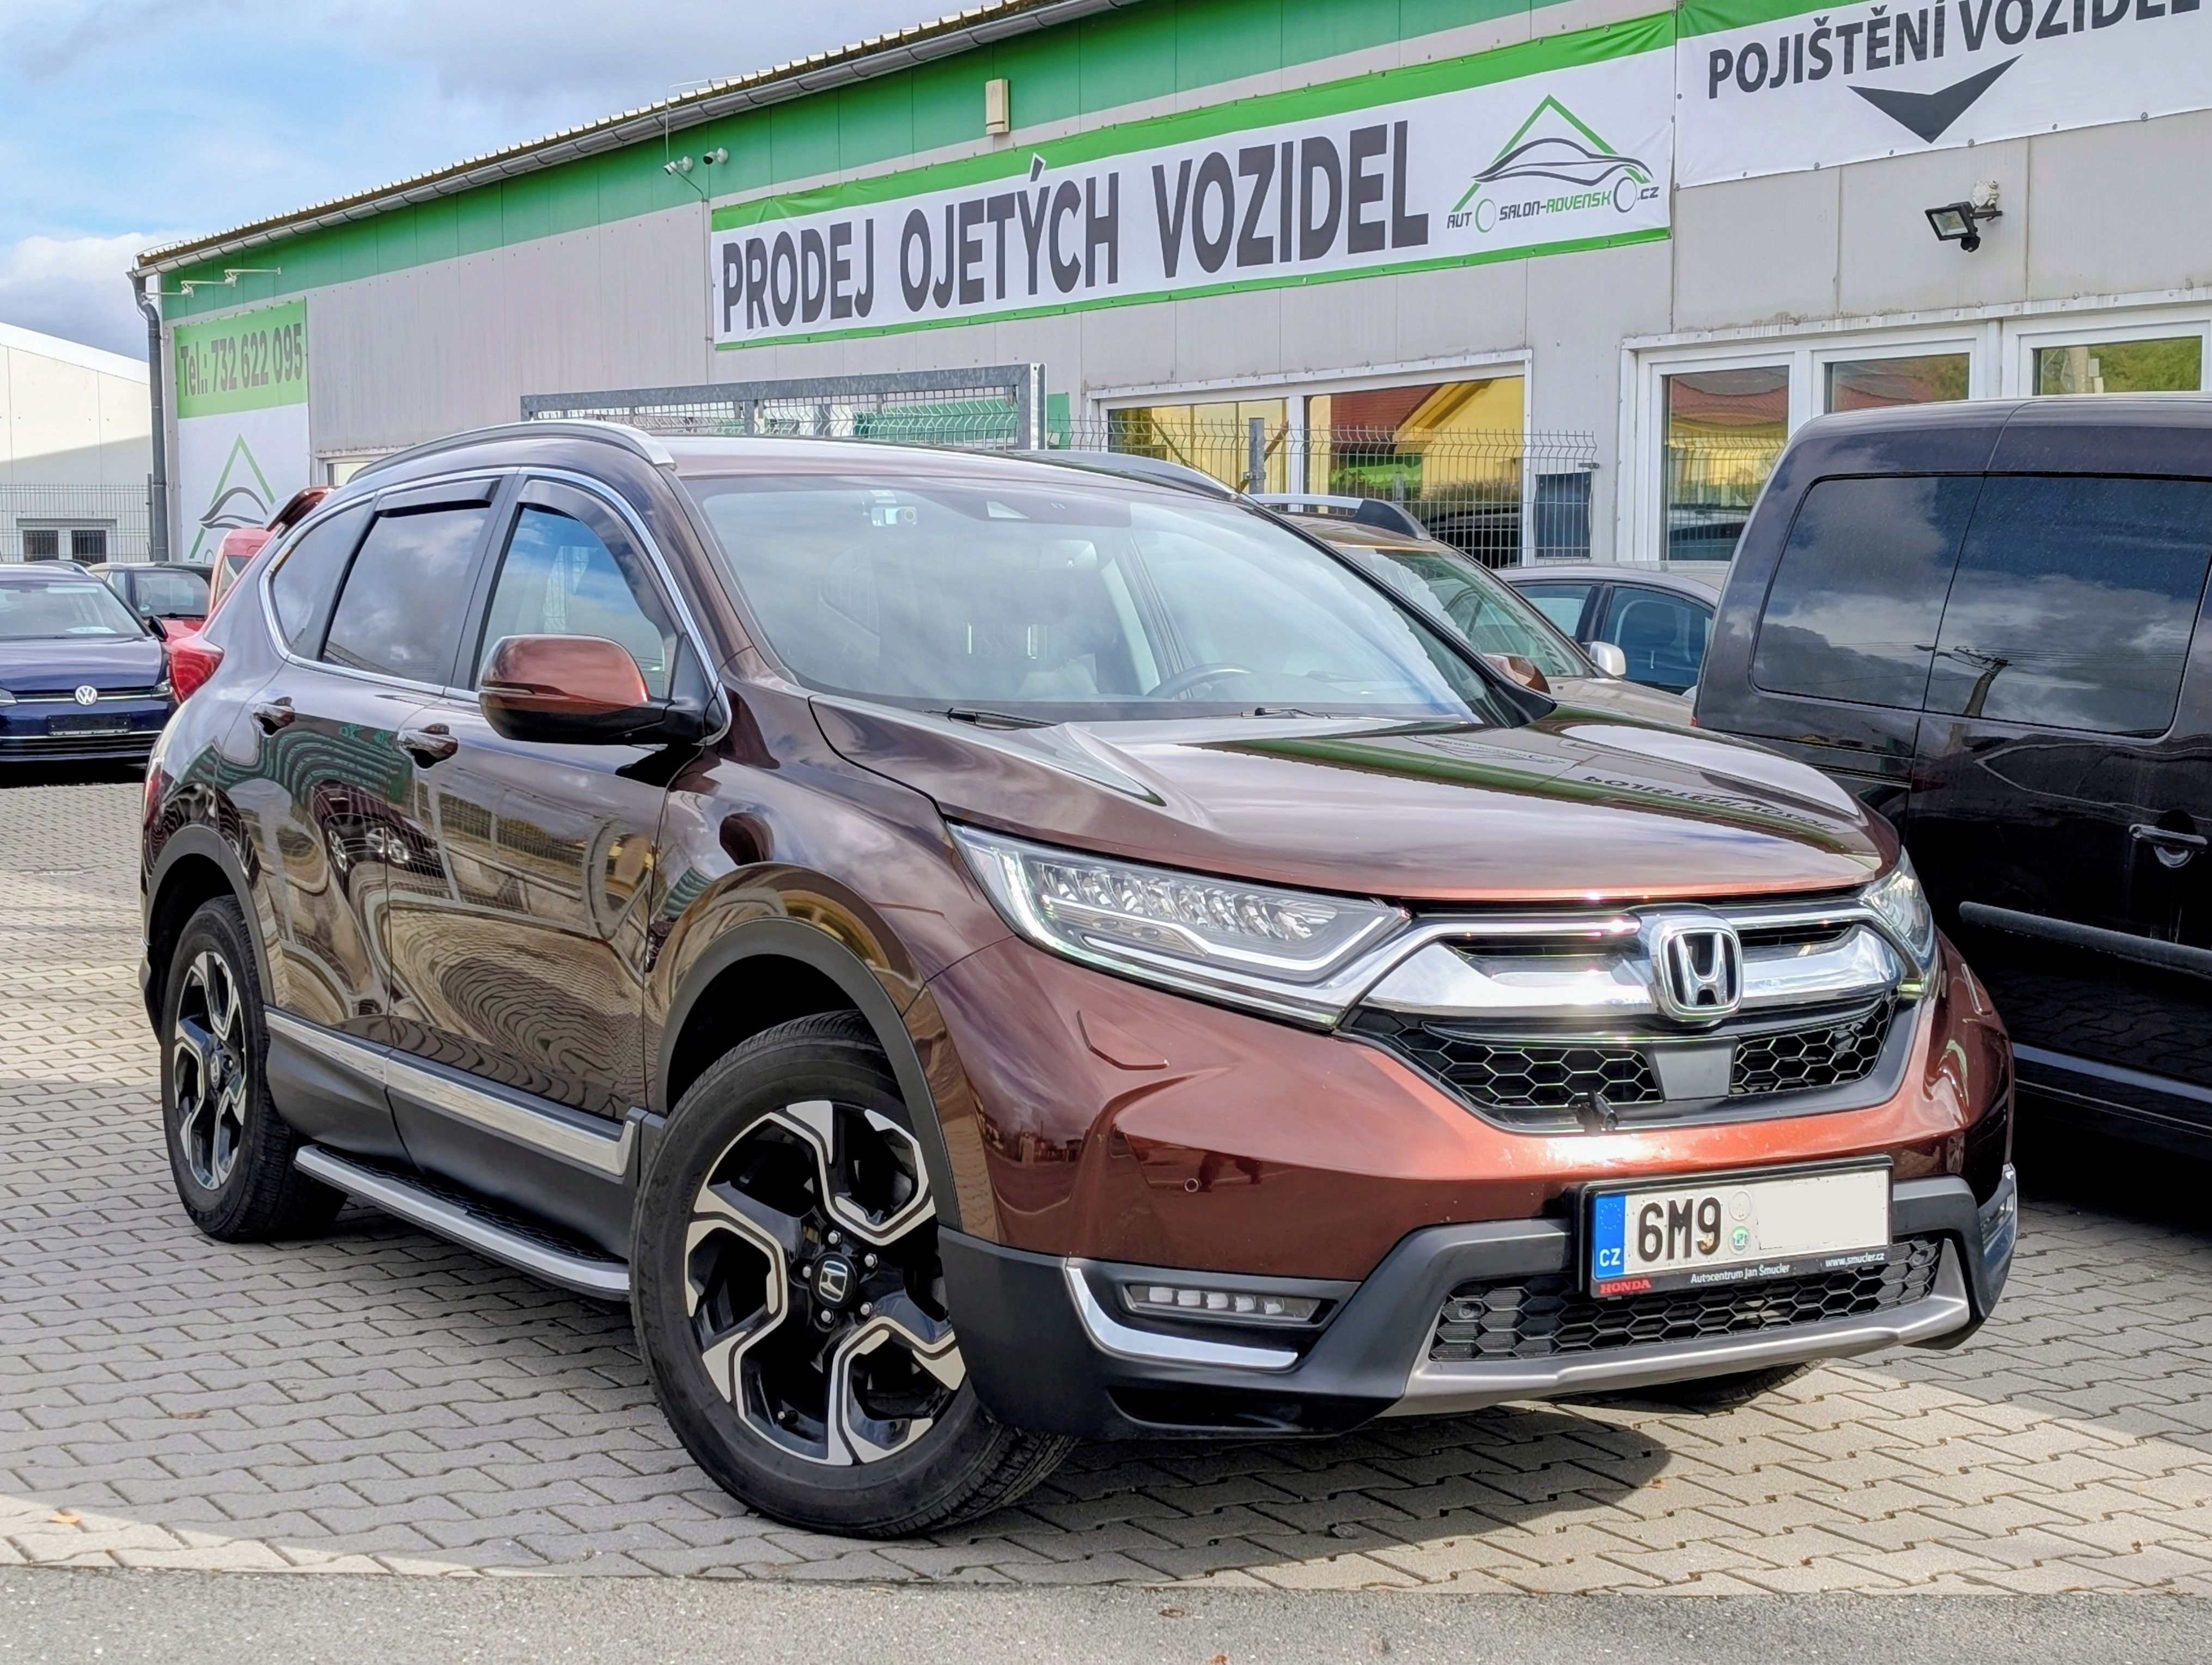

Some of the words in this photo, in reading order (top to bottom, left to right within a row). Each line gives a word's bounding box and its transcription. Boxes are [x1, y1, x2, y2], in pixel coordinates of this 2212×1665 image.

[1708, 0, 1945, 99] POJIŠTĚNÍ
[1959, 0, 2200, 52] VOZID
[723, 218, 874, 333] PRODEJ
[900, 156, 1119, 313] OJETÝCH
[1151, 120, 1429, 279] VOZIDEL
[180, 341, 208, 396] Tel.:
[211, 336, 237, 392] 732
[241, 330, 269, 388] 622
[273, 322, 303, 383] 095
[1600, 1248, 1620, 1267] CZ
[1638, 1197, 1721, 1261] 6M9
[1600, 1279, 1652, 1294] HONDA
[1691, 1270, 1743, 1284] Autocentrum
